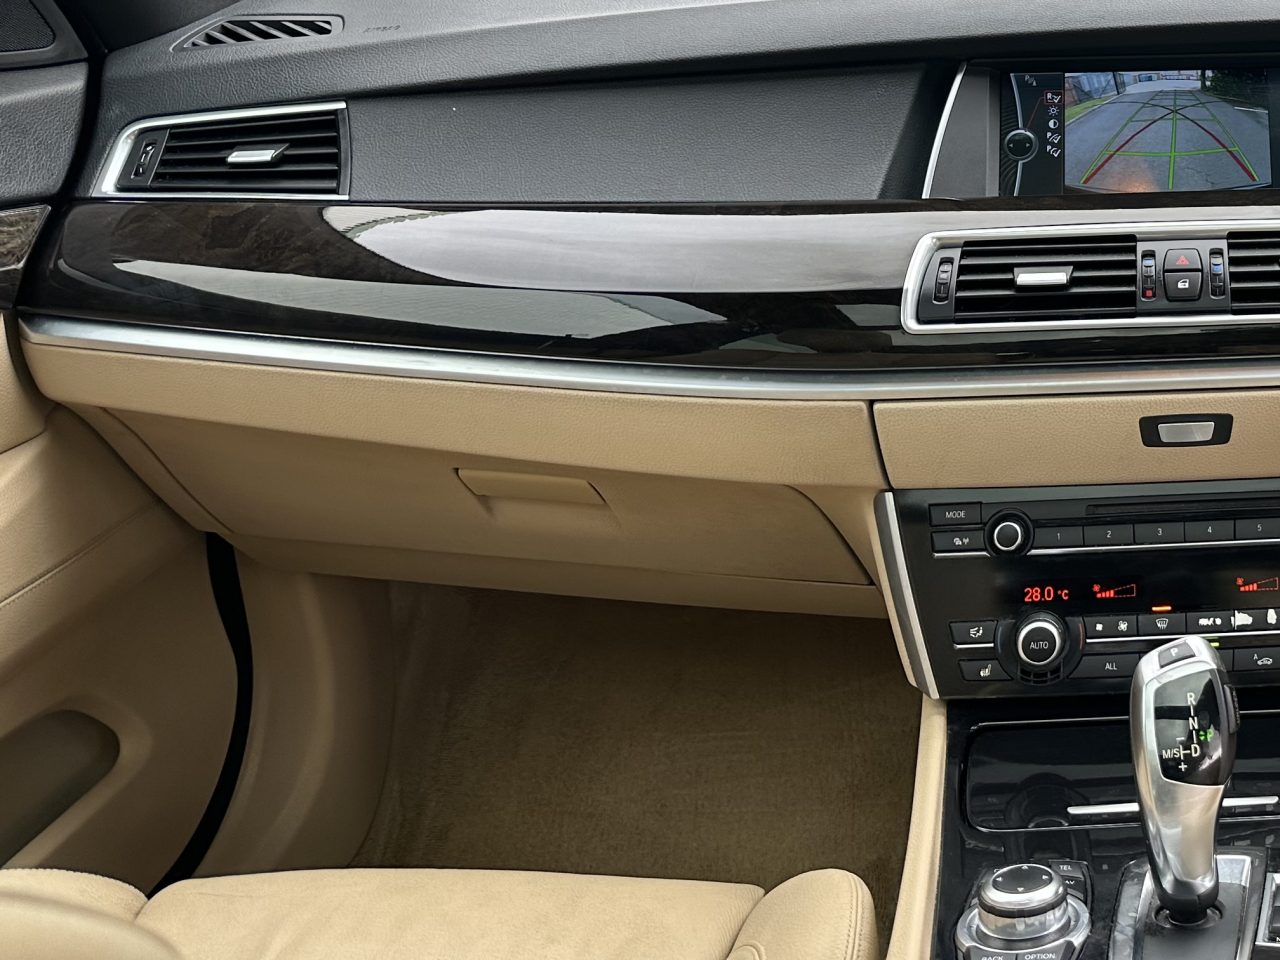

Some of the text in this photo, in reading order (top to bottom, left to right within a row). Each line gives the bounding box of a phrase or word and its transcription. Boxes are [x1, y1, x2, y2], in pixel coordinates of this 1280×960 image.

[945, 510, 966, 519] MODE
[1257, 523, 1262, 531] 5
[1106, 530, 1112, 538] 2
[1157, 528, 1162, 536] 3
[1023, 586, 1054, 603] 28.0
[1029, 641, 1049, 650] AUTO
[1169, 647, 1179, 657] P
[1105, 662, 1118, 671] ALL
[1186, 692, 1196, 705] R
[1188, 716, 1199, 730] N
[1162, 744, 1200, 759] M/S D
[1024, 952, 1056, 960] OPTION
